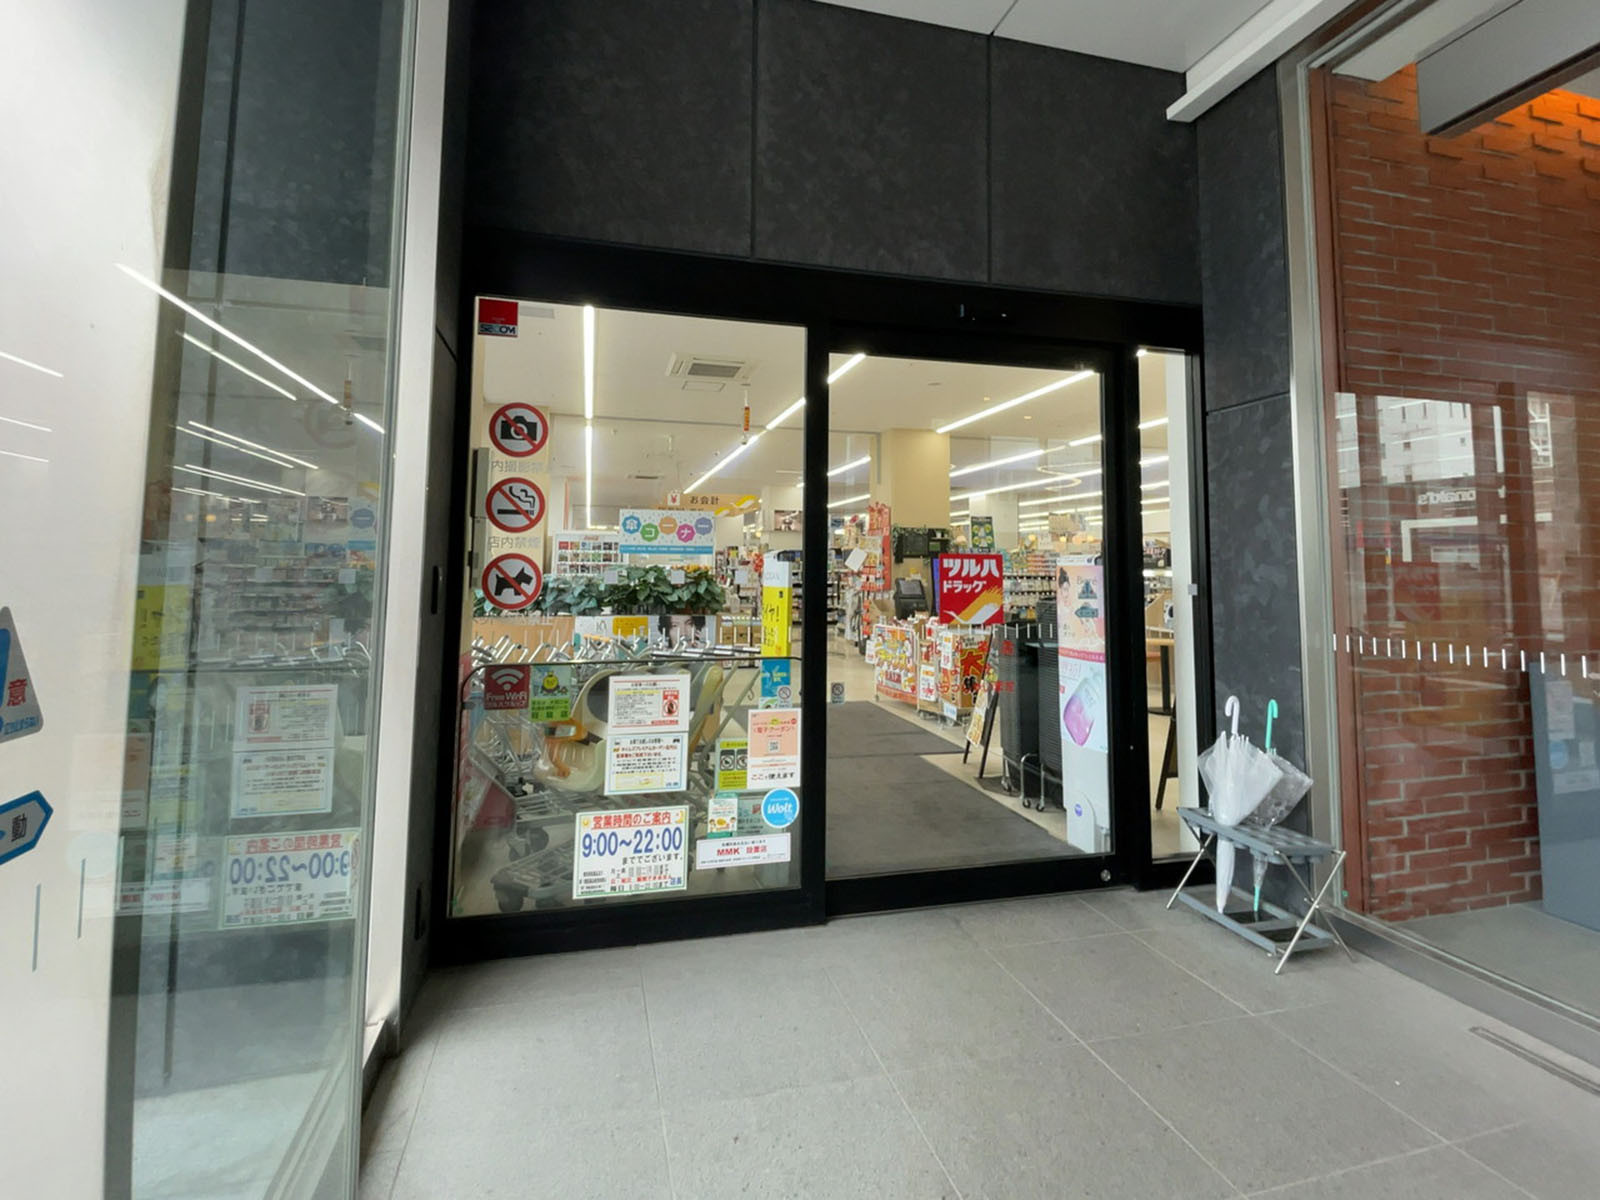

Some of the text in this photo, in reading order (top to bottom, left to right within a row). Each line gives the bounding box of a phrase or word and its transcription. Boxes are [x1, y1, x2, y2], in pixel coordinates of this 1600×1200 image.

[690, 495, 720, 505] お会計
[942, 558, 1000, 577] ツルハ
[942, 580, 987, 593] ドラッグ
[767, 802, 792, 814] Wolt
[592, 811, 671, 829] 営業時間のご案内
[717, 847, 740, 856] MMK
